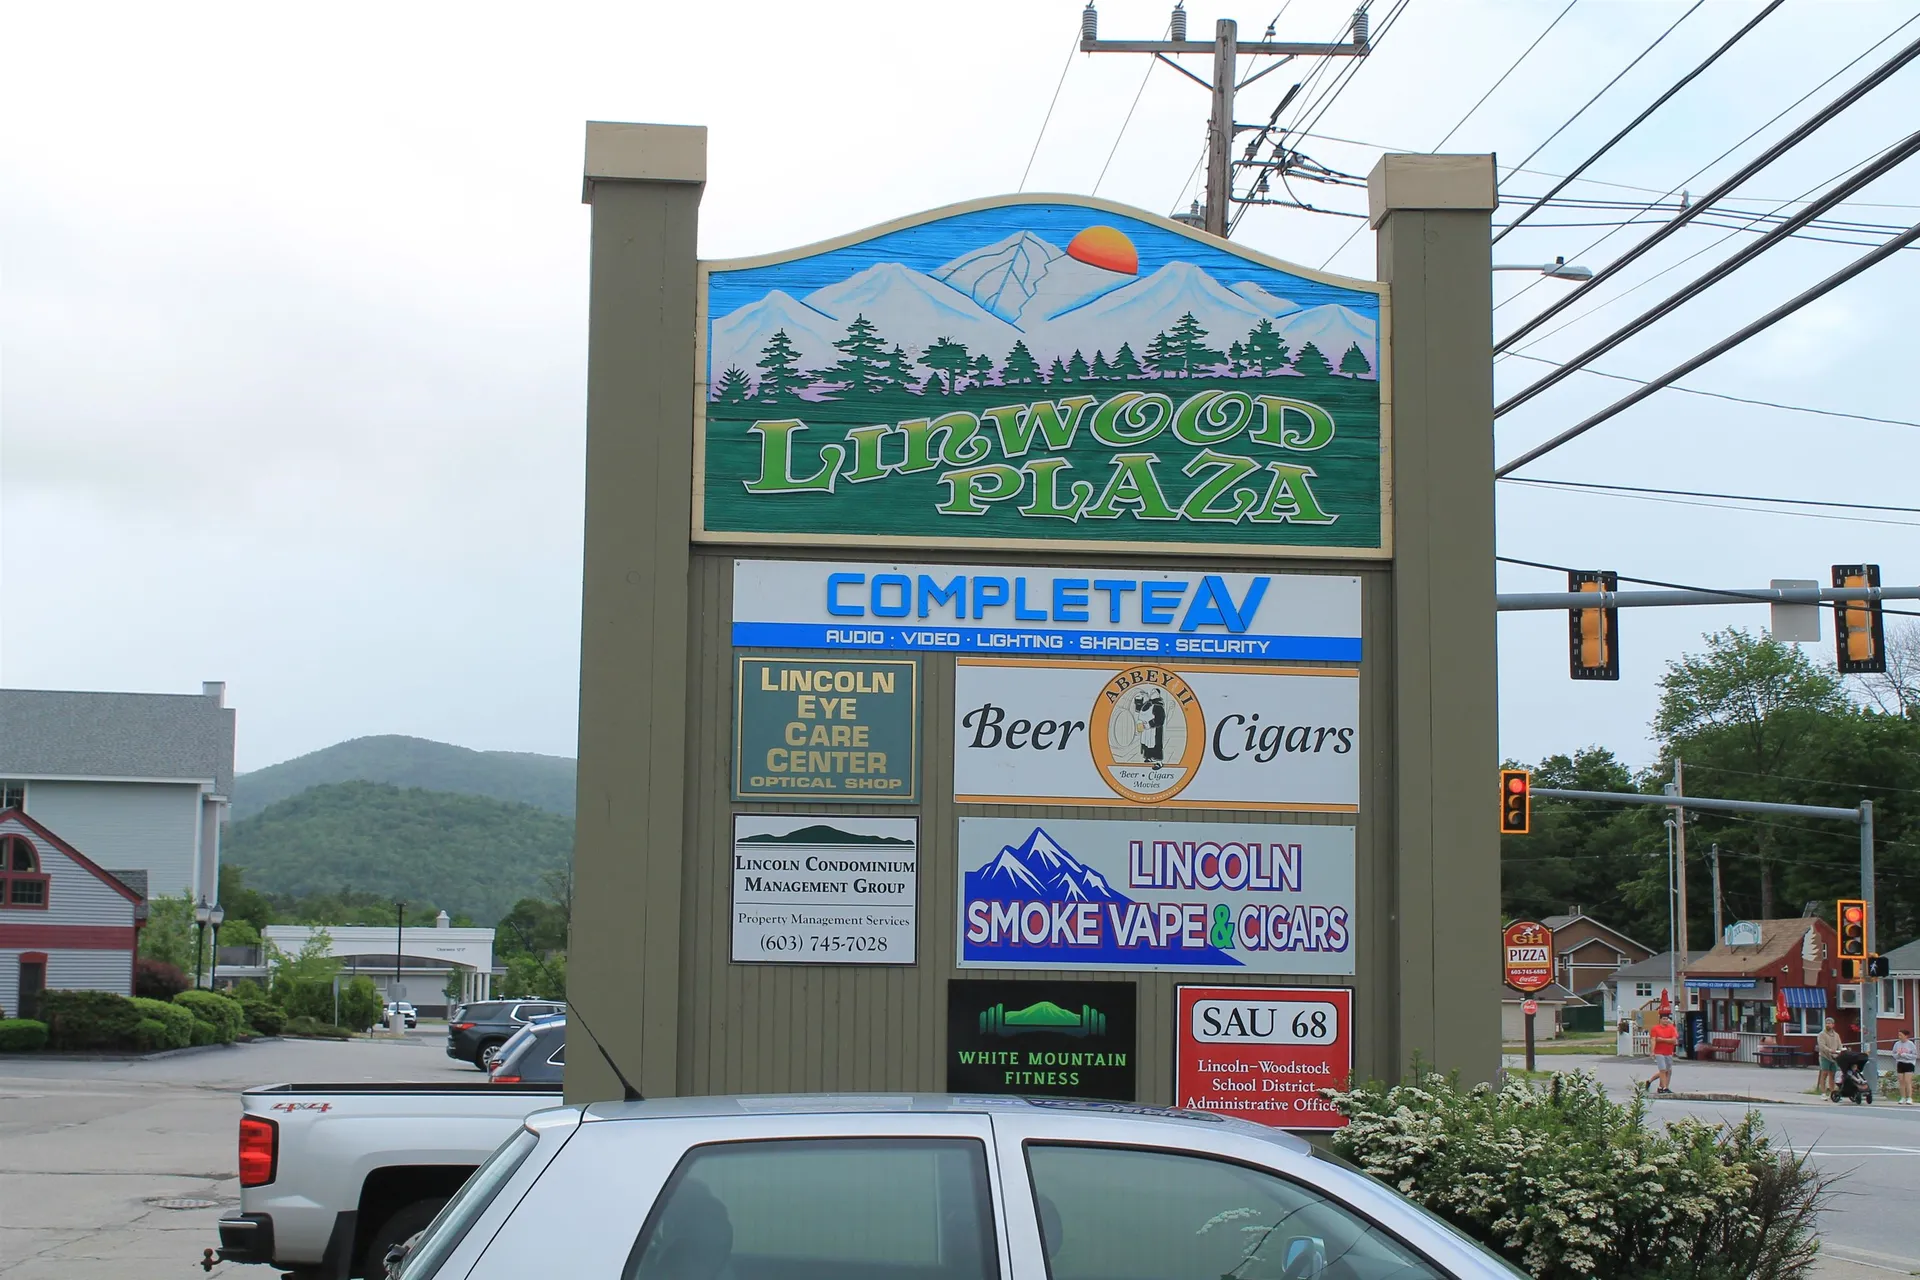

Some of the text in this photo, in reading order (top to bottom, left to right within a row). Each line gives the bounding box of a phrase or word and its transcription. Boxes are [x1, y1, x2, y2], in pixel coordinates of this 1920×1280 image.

[935, 448, 1340, 526] PLAZA
[826, 629, 1271, 655] AUDIO VIDEO LIGHTING SHADES SECURITY
[761, 667, 895, 694] LINCOLN
[1105, 669, 1195, 706] ABBEY II
[797, 694, 857, 720] EYE
[784, 721, 869, 748] CARE
[962, 702, 1354, 763] Beer Cigars
[766, 747, 887, 774] CENTER
[750, 776, 902, 790] OPTICAL SHOP
[1119, 770, 1175, 781] Beer Cigars
[1133, 780, 1161, 789] Movies
[736, 855, 915, 873] LINCOLN CONDOMINIUM
[1129, 840, 1303, 892] LINCOLN
[744, 876, 906, 894] MANAGEMENT GROUP
[738, 912, 910, 927] Property Management Services
[966, 900, 1350, 953] SMOKE VAPE & CIGARS
[760, 934, 888, 953] (603) 745-7028
[1509, 948, 1547, 961] PIZZA
[1202, 1006, 1328, 1039] SAU 68
[958, 1050, 1127, 1068] WHITE MOUNTAIN
[1198, 1059, 1331, 1075] Lincoln-Woodstock
[1005, 1071, 1080, 1087] FITNESS
[1212, 1078, 1316, 1093] School District
[1186, 1096, 1340, 1112] Administrative Office
